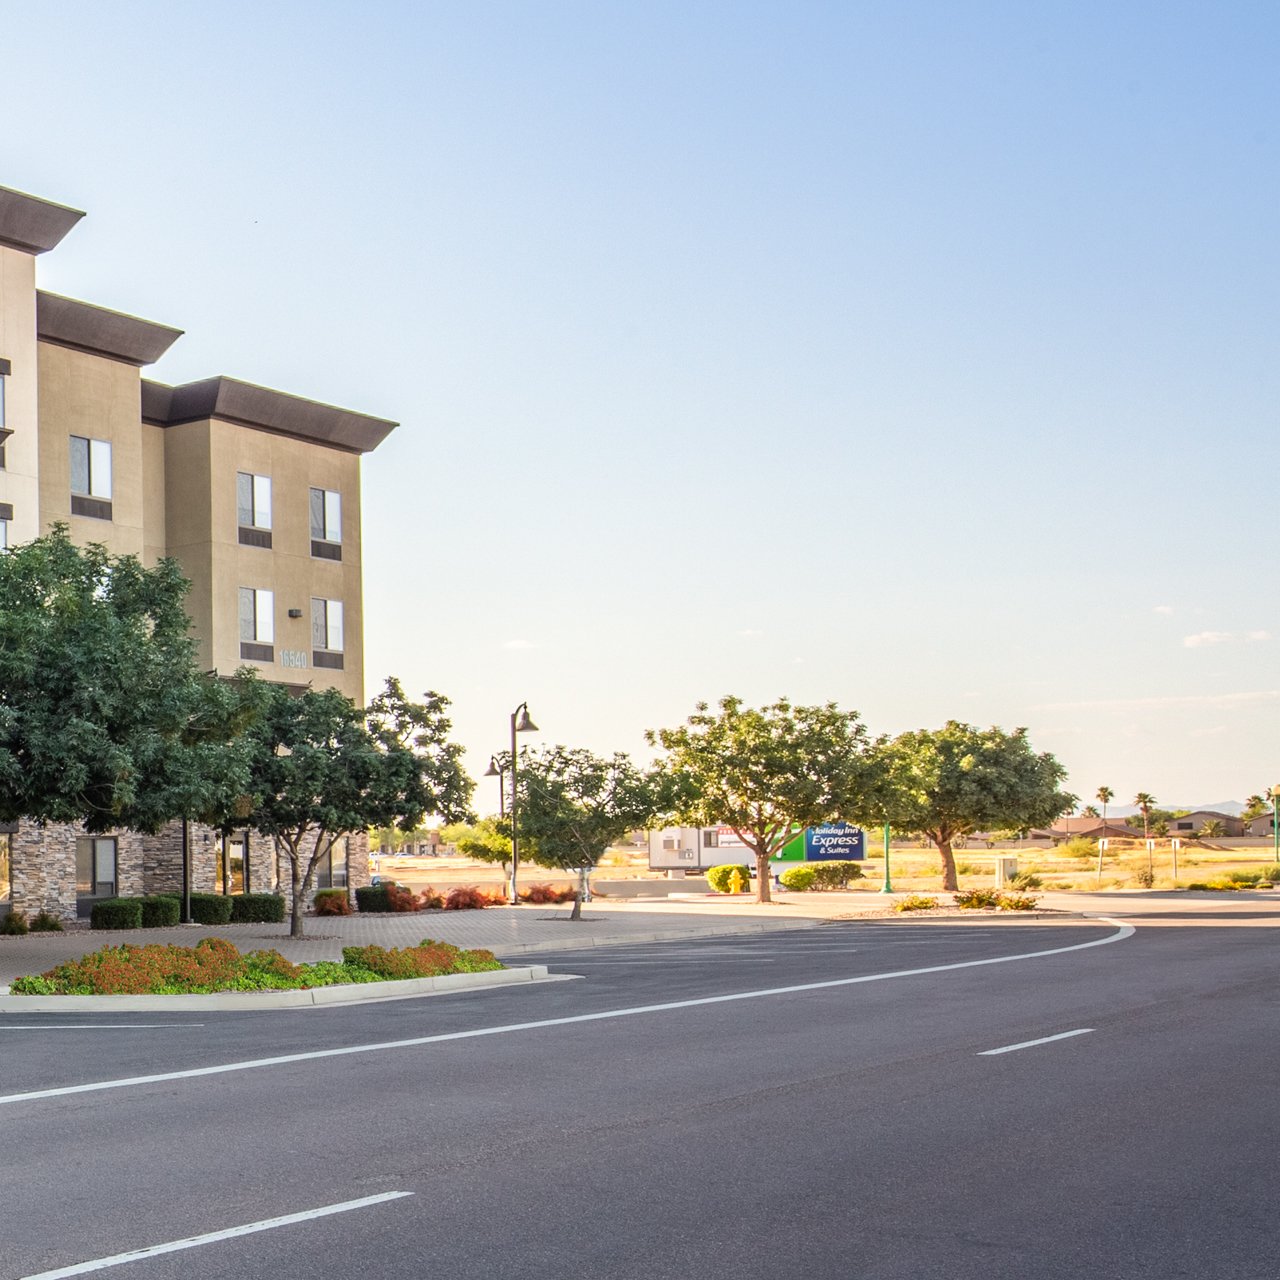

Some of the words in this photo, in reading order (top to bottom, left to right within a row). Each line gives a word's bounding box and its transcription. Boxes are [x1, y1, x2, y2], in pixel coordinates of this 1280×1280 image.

[279, 649, 307, 669] 16540
[844, 826, 859, 834] Inn
[811, 835, 859, 847] Express
